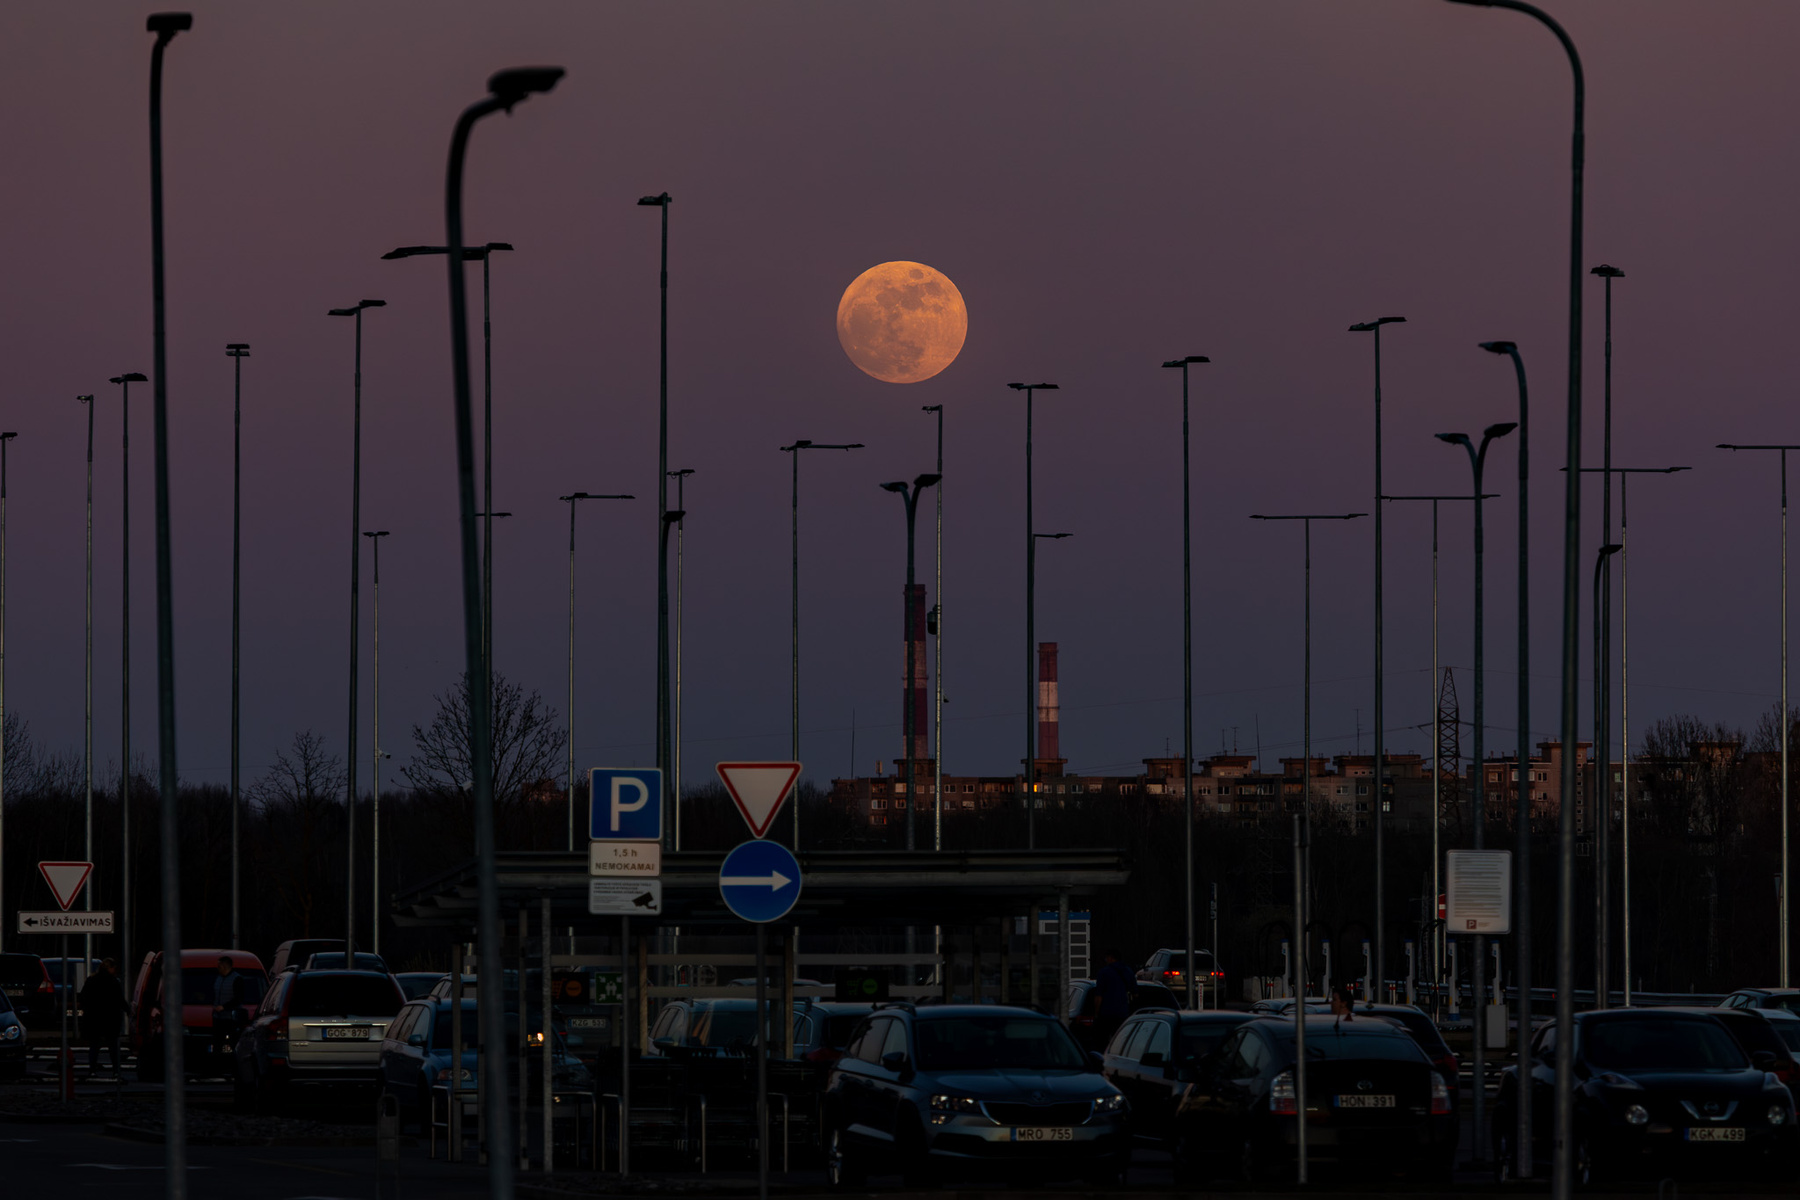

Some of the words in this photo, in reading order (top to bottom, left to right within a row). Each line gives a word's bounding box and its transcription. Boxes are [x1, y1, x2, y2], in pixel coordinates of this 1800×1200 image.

[610, 776, 649, 832] P
[613, 848, 628, 858] 1,5
[631, 849, 638, 857] h
[595, 862, 655, 871] NEMOKAMAI
[40, 916, 111, 927] IŠVAŽIAVIMAS
[327, 1029, 346, 1037] GOG
[351, 1029, 368, 1037] 879
[1340, 1096, 1365, 1106] HON
[1373, 1096, 1393, 1106] 391
[1018, 1128, 1043, 1140] MRO
[1050, 1128, 1071, 1140] 755
[1690, 1129, 1715, 1140] KGK
[1722, 1129, 1744, 1140] 499
